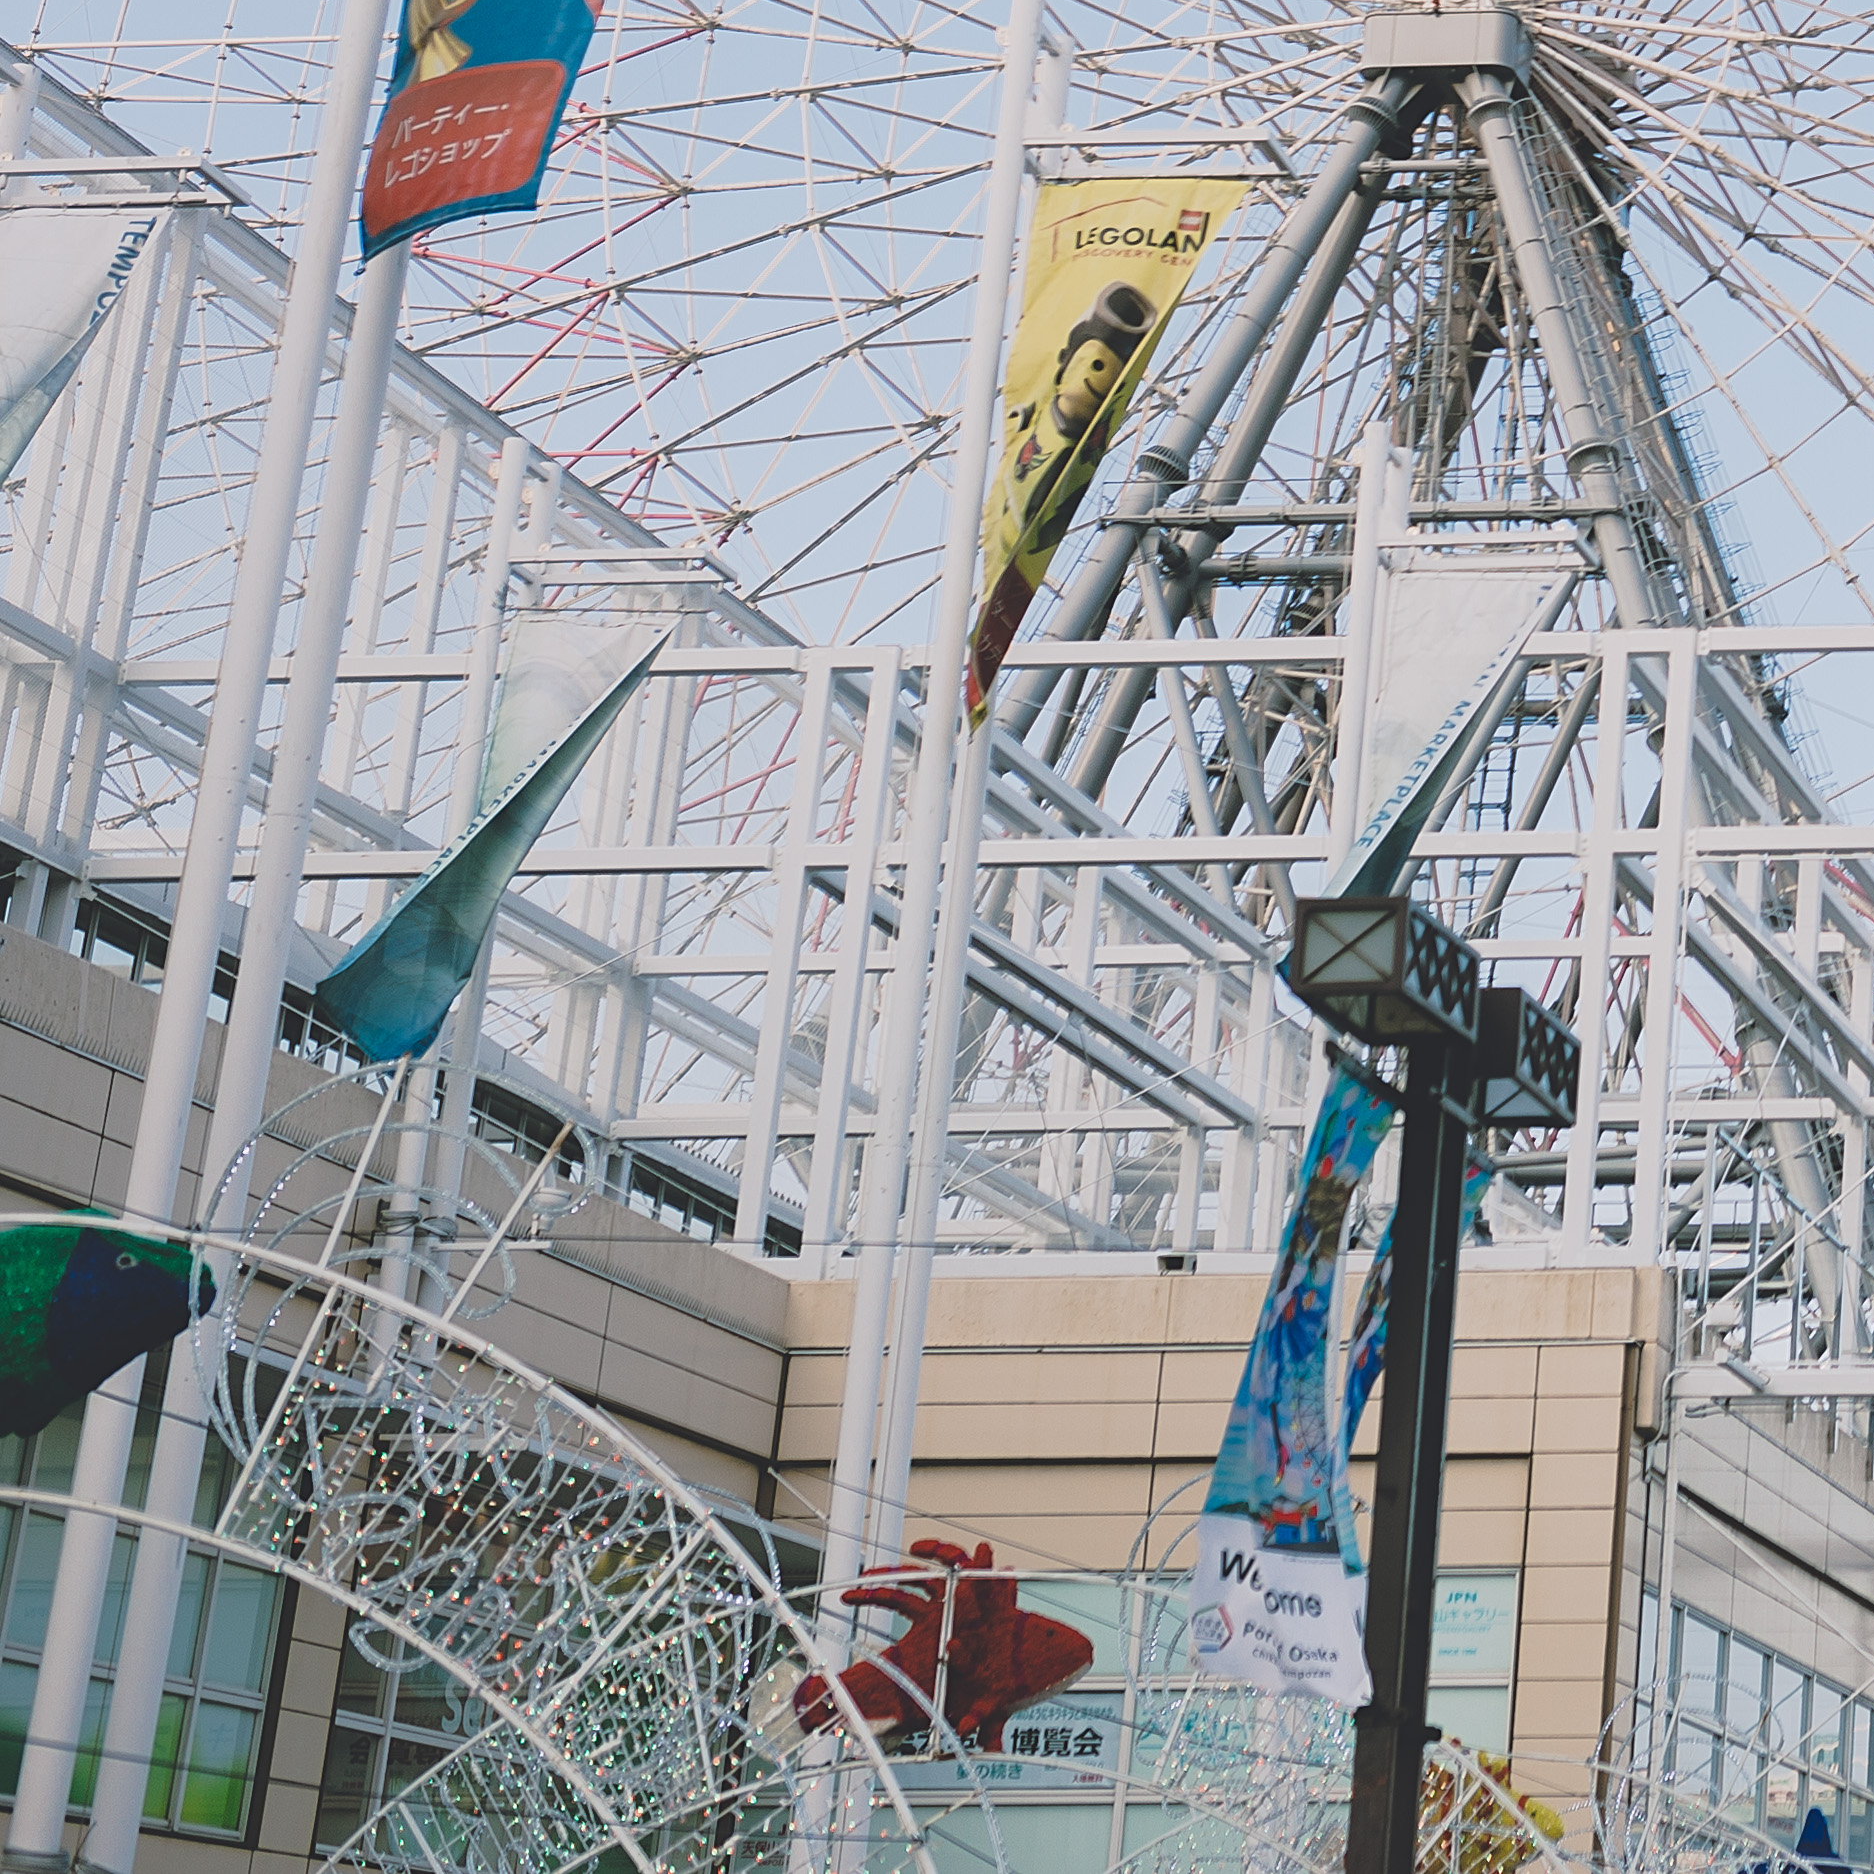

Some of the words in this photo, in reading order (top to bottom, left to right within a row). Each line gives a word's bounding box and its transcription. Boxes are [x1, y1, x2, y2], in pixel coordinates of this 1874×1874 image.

[384, 128, 513, 189] レゴショップ
[1353, 700, 1472, 849] MARKETPLACE
[1288, 1645, 1338, 1663] Osaka
[1010, 1727, 1103, 1757] 博覧会
